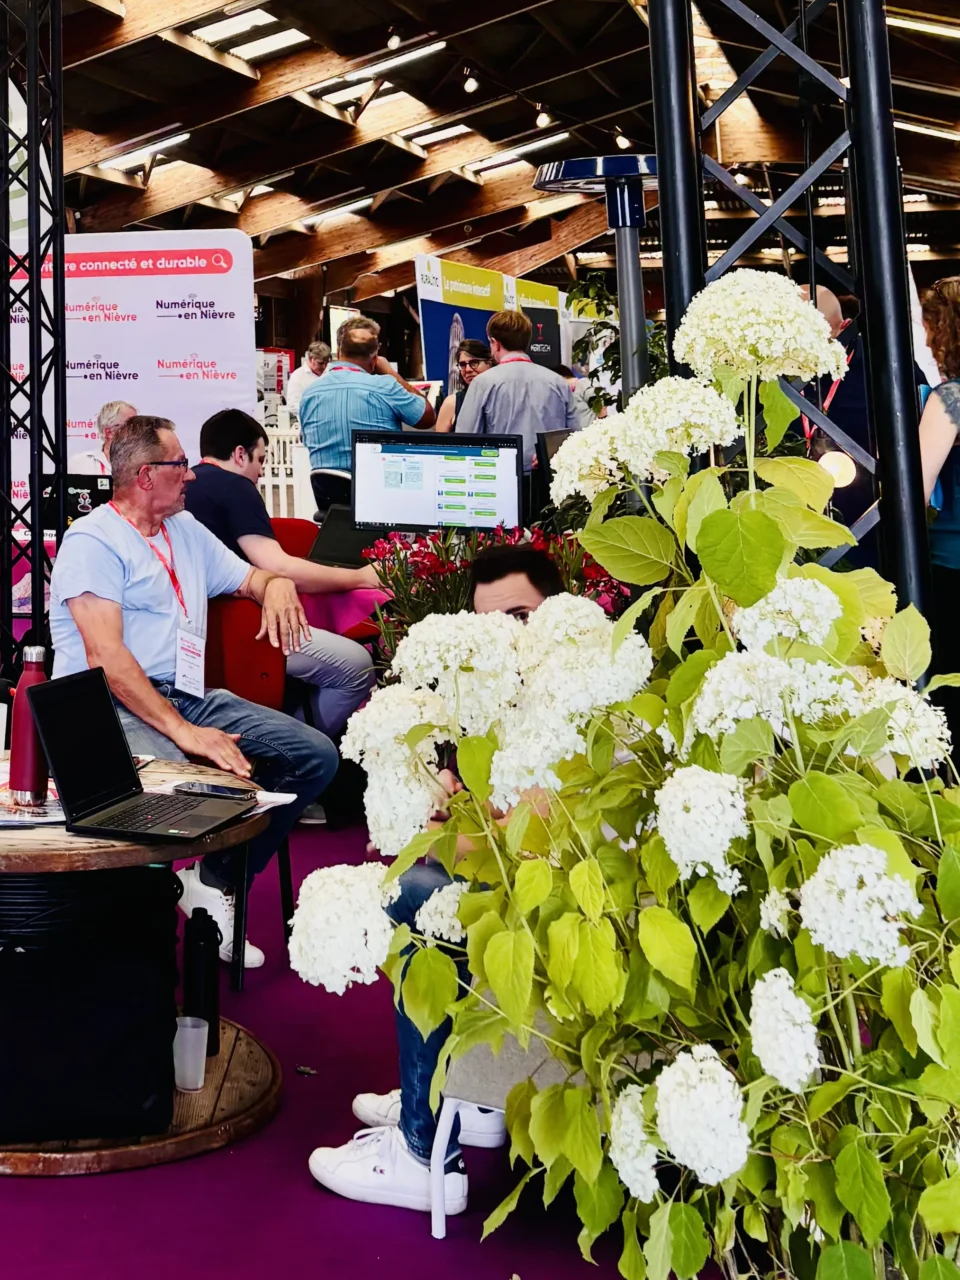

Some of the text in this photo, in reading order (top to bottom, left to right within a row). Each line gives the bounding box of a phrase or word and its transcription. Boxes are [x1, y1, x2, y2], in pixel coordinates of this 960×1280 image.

[79, 257, 137, 271] connecté
[140, 258, 154, 270] et
[157, 256, 208, 270] durable
[156, 297, 216, 311] Numérique
[89, 310, 138, 322] en Nièvre
[184, 308, 236, 321] en Nièvre
[157, 357, 217, 371] Numérique
[89, 369, 139, 381] en Nièvre
[185, 368, 237, 380] en Nièvre
